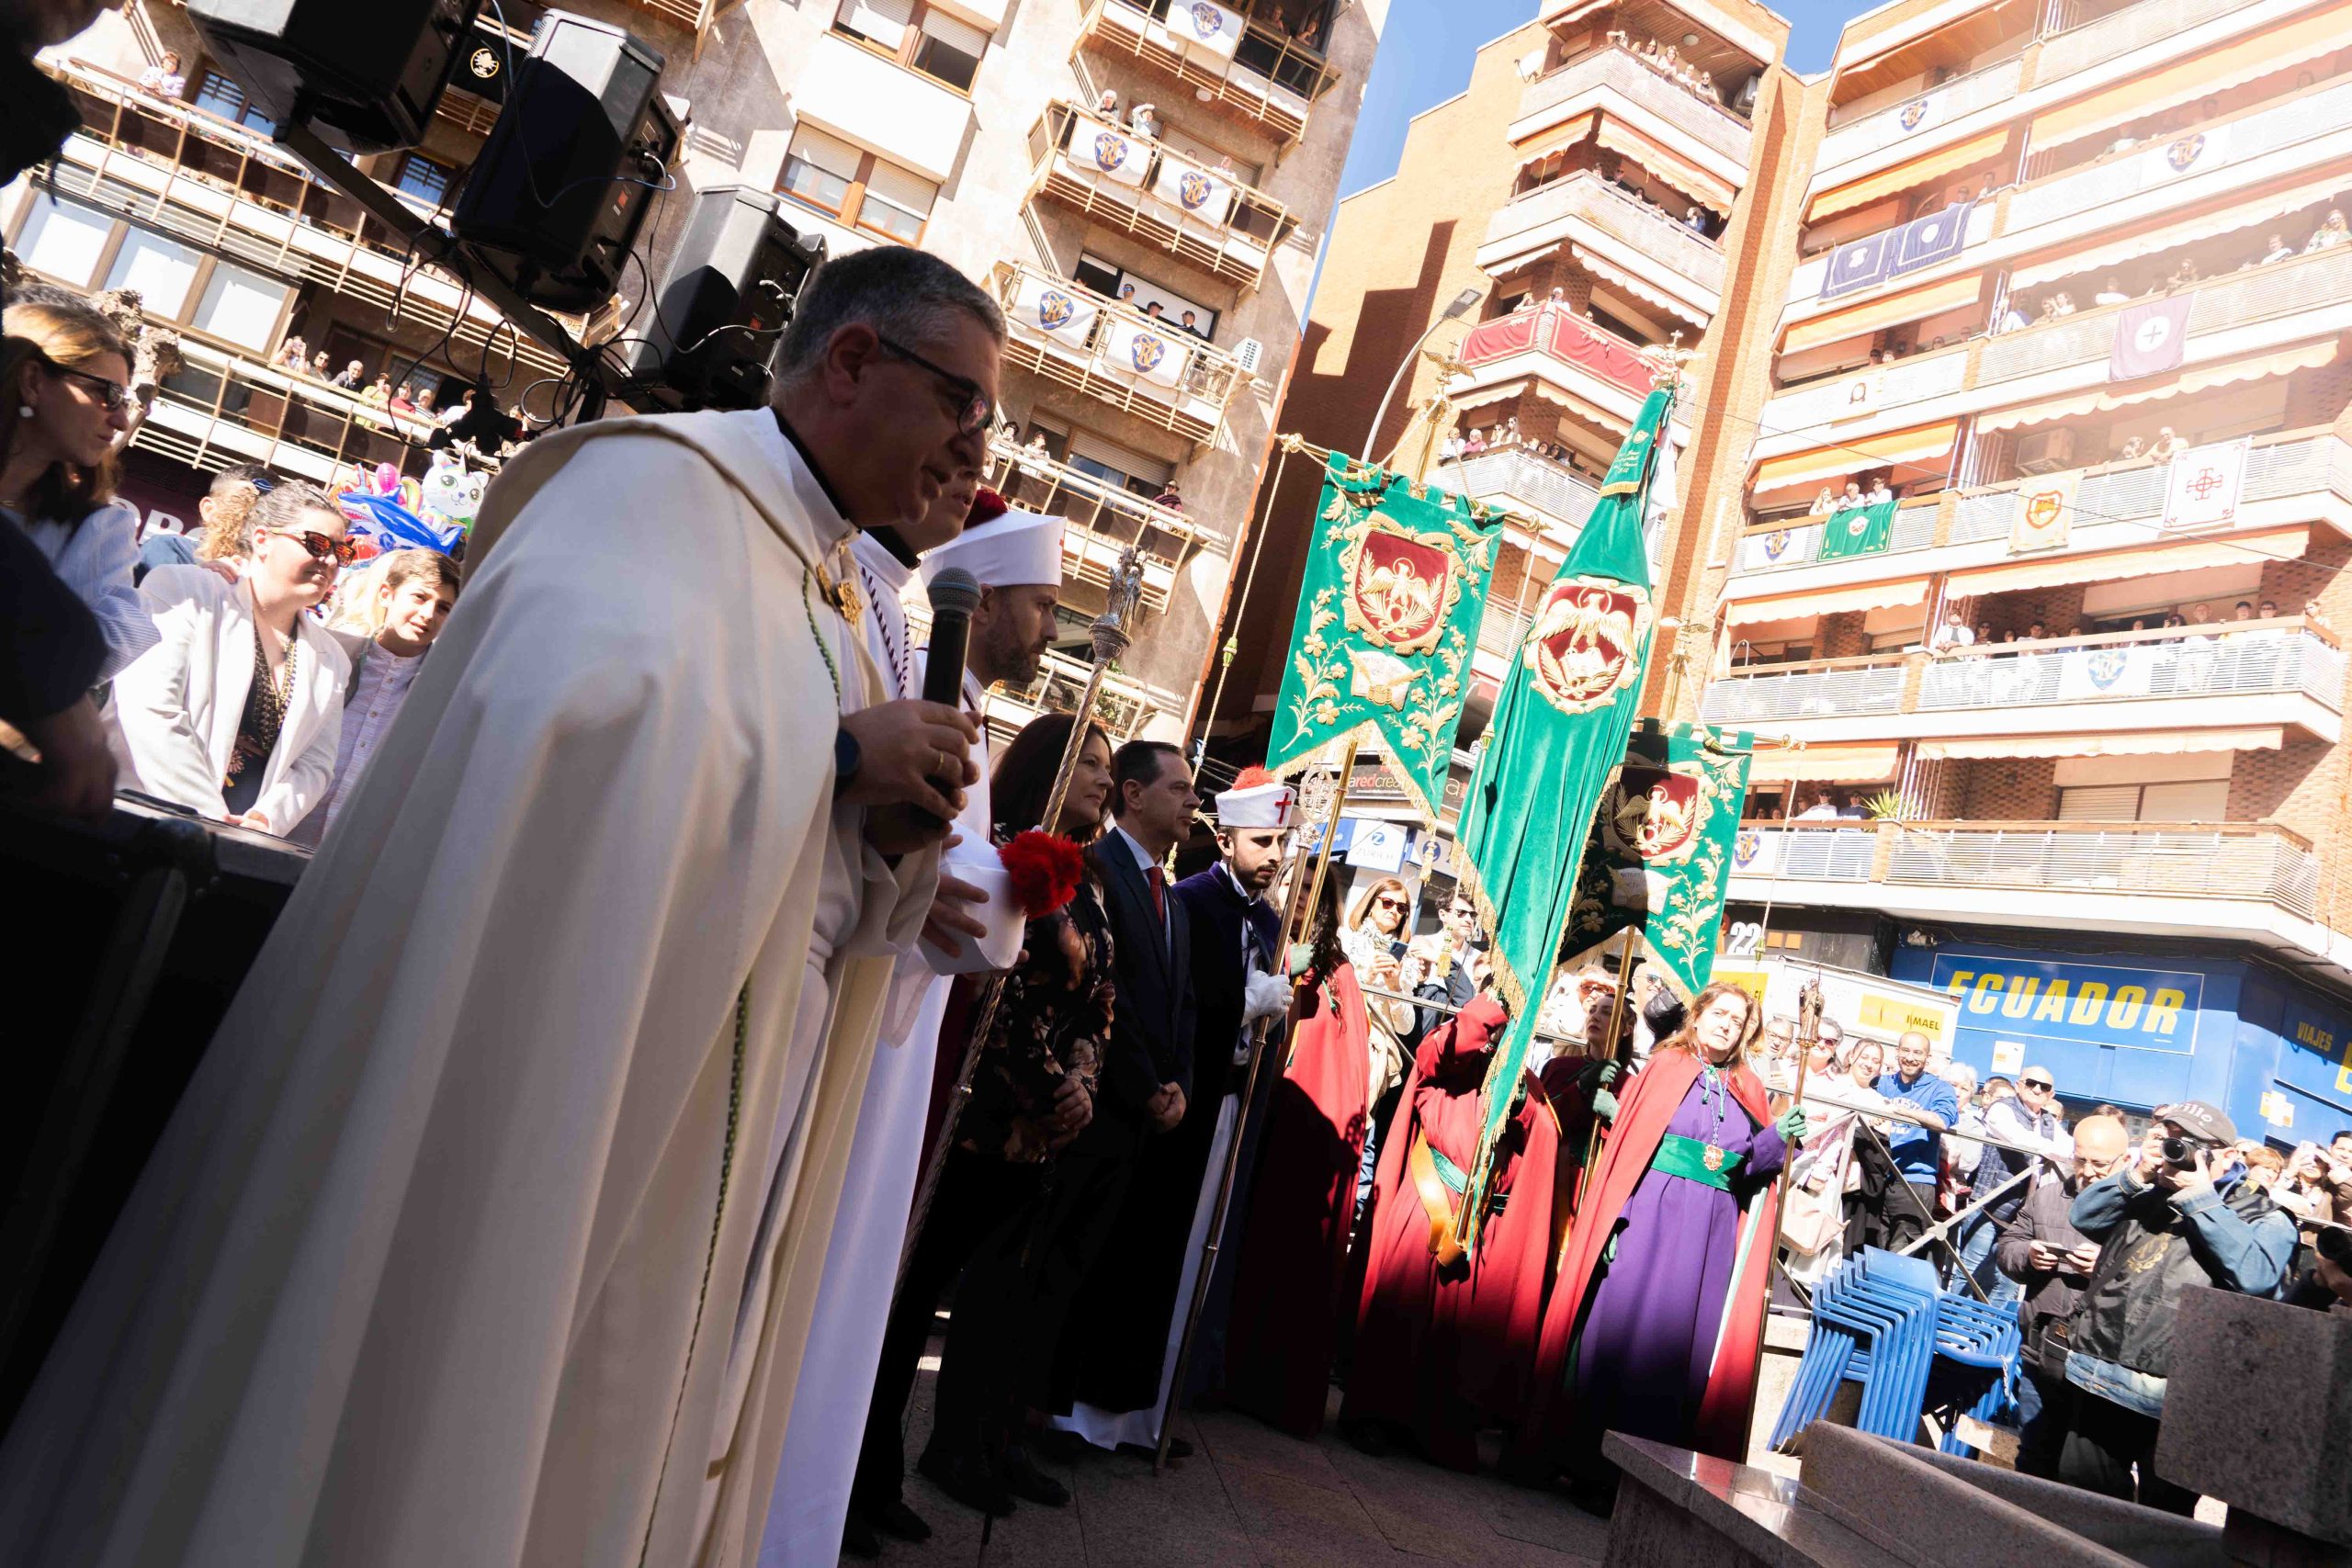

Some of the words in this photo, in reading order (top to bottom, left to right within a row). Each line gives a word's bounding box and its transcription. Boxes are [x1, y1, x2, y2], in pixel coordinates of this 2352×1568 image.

[1947, 970, 2186, 1035] ECUADOR
[1905, 1013, 1939, 1031] IMAEL
[2297, 1021, 2334, 1053] VIAJES
